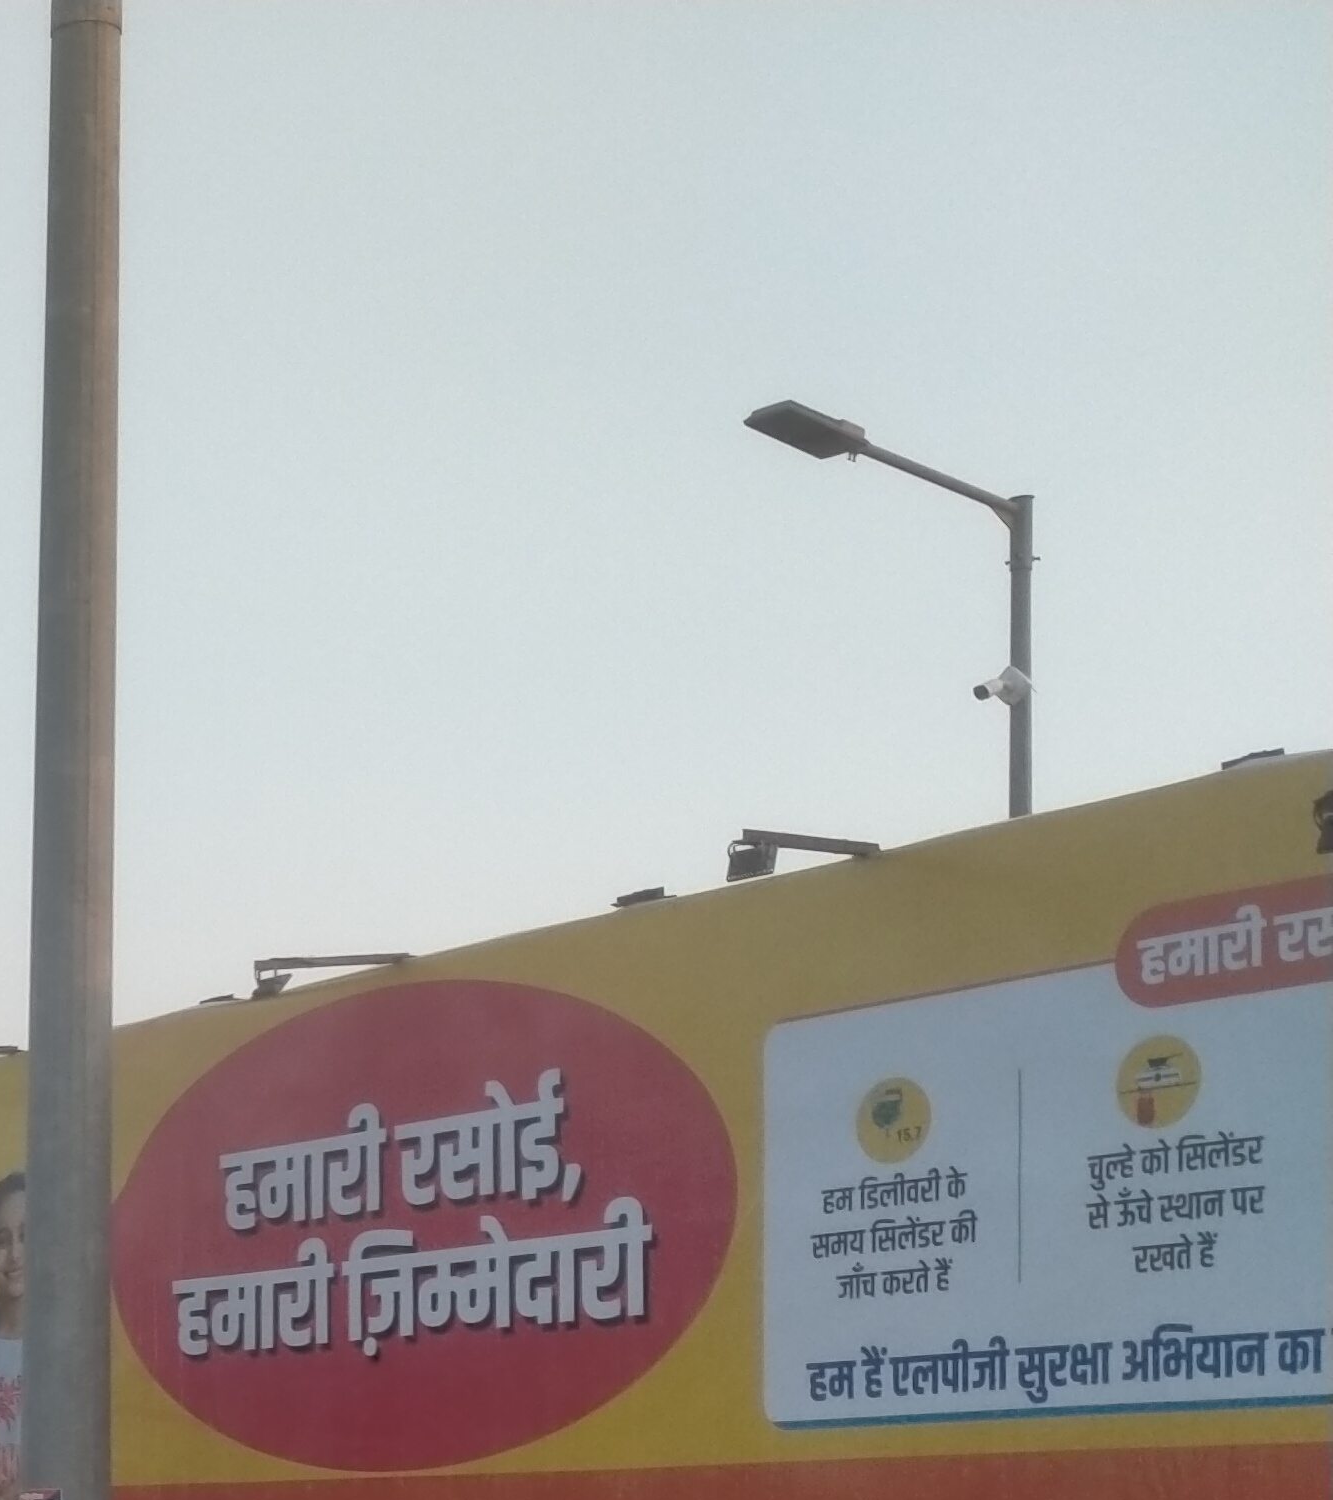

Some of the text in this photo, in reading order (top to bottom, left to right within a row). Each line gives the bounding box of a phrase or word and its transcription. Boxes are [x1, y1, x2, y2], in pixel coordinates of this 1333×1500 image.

[1137, 904, 1267, 985] हमारी
[220, 1067, 582, 1230] हमारी रसोई,
[1087, 1131, 1264, 1191] चुल्हे को सिलेंडर
[821, 1166, 968, 1214] हम डिलीवरी के
[1086, 1185, 1265, 1230] से ऊँचे स्थान पर
[810, 1209, 978, 1259] समय सिलेंडर की
[1132, 1230, 1218, 1273] रखते हैं
[172, 1196, 653, 1358] हमारी ज़िम्मेदारी
[836, 1258, 953, 1299] जाँच करते हैं
[806, 1323, 1325, 1403] हम हैं एलपीजी सुरक्षा अभियान का
